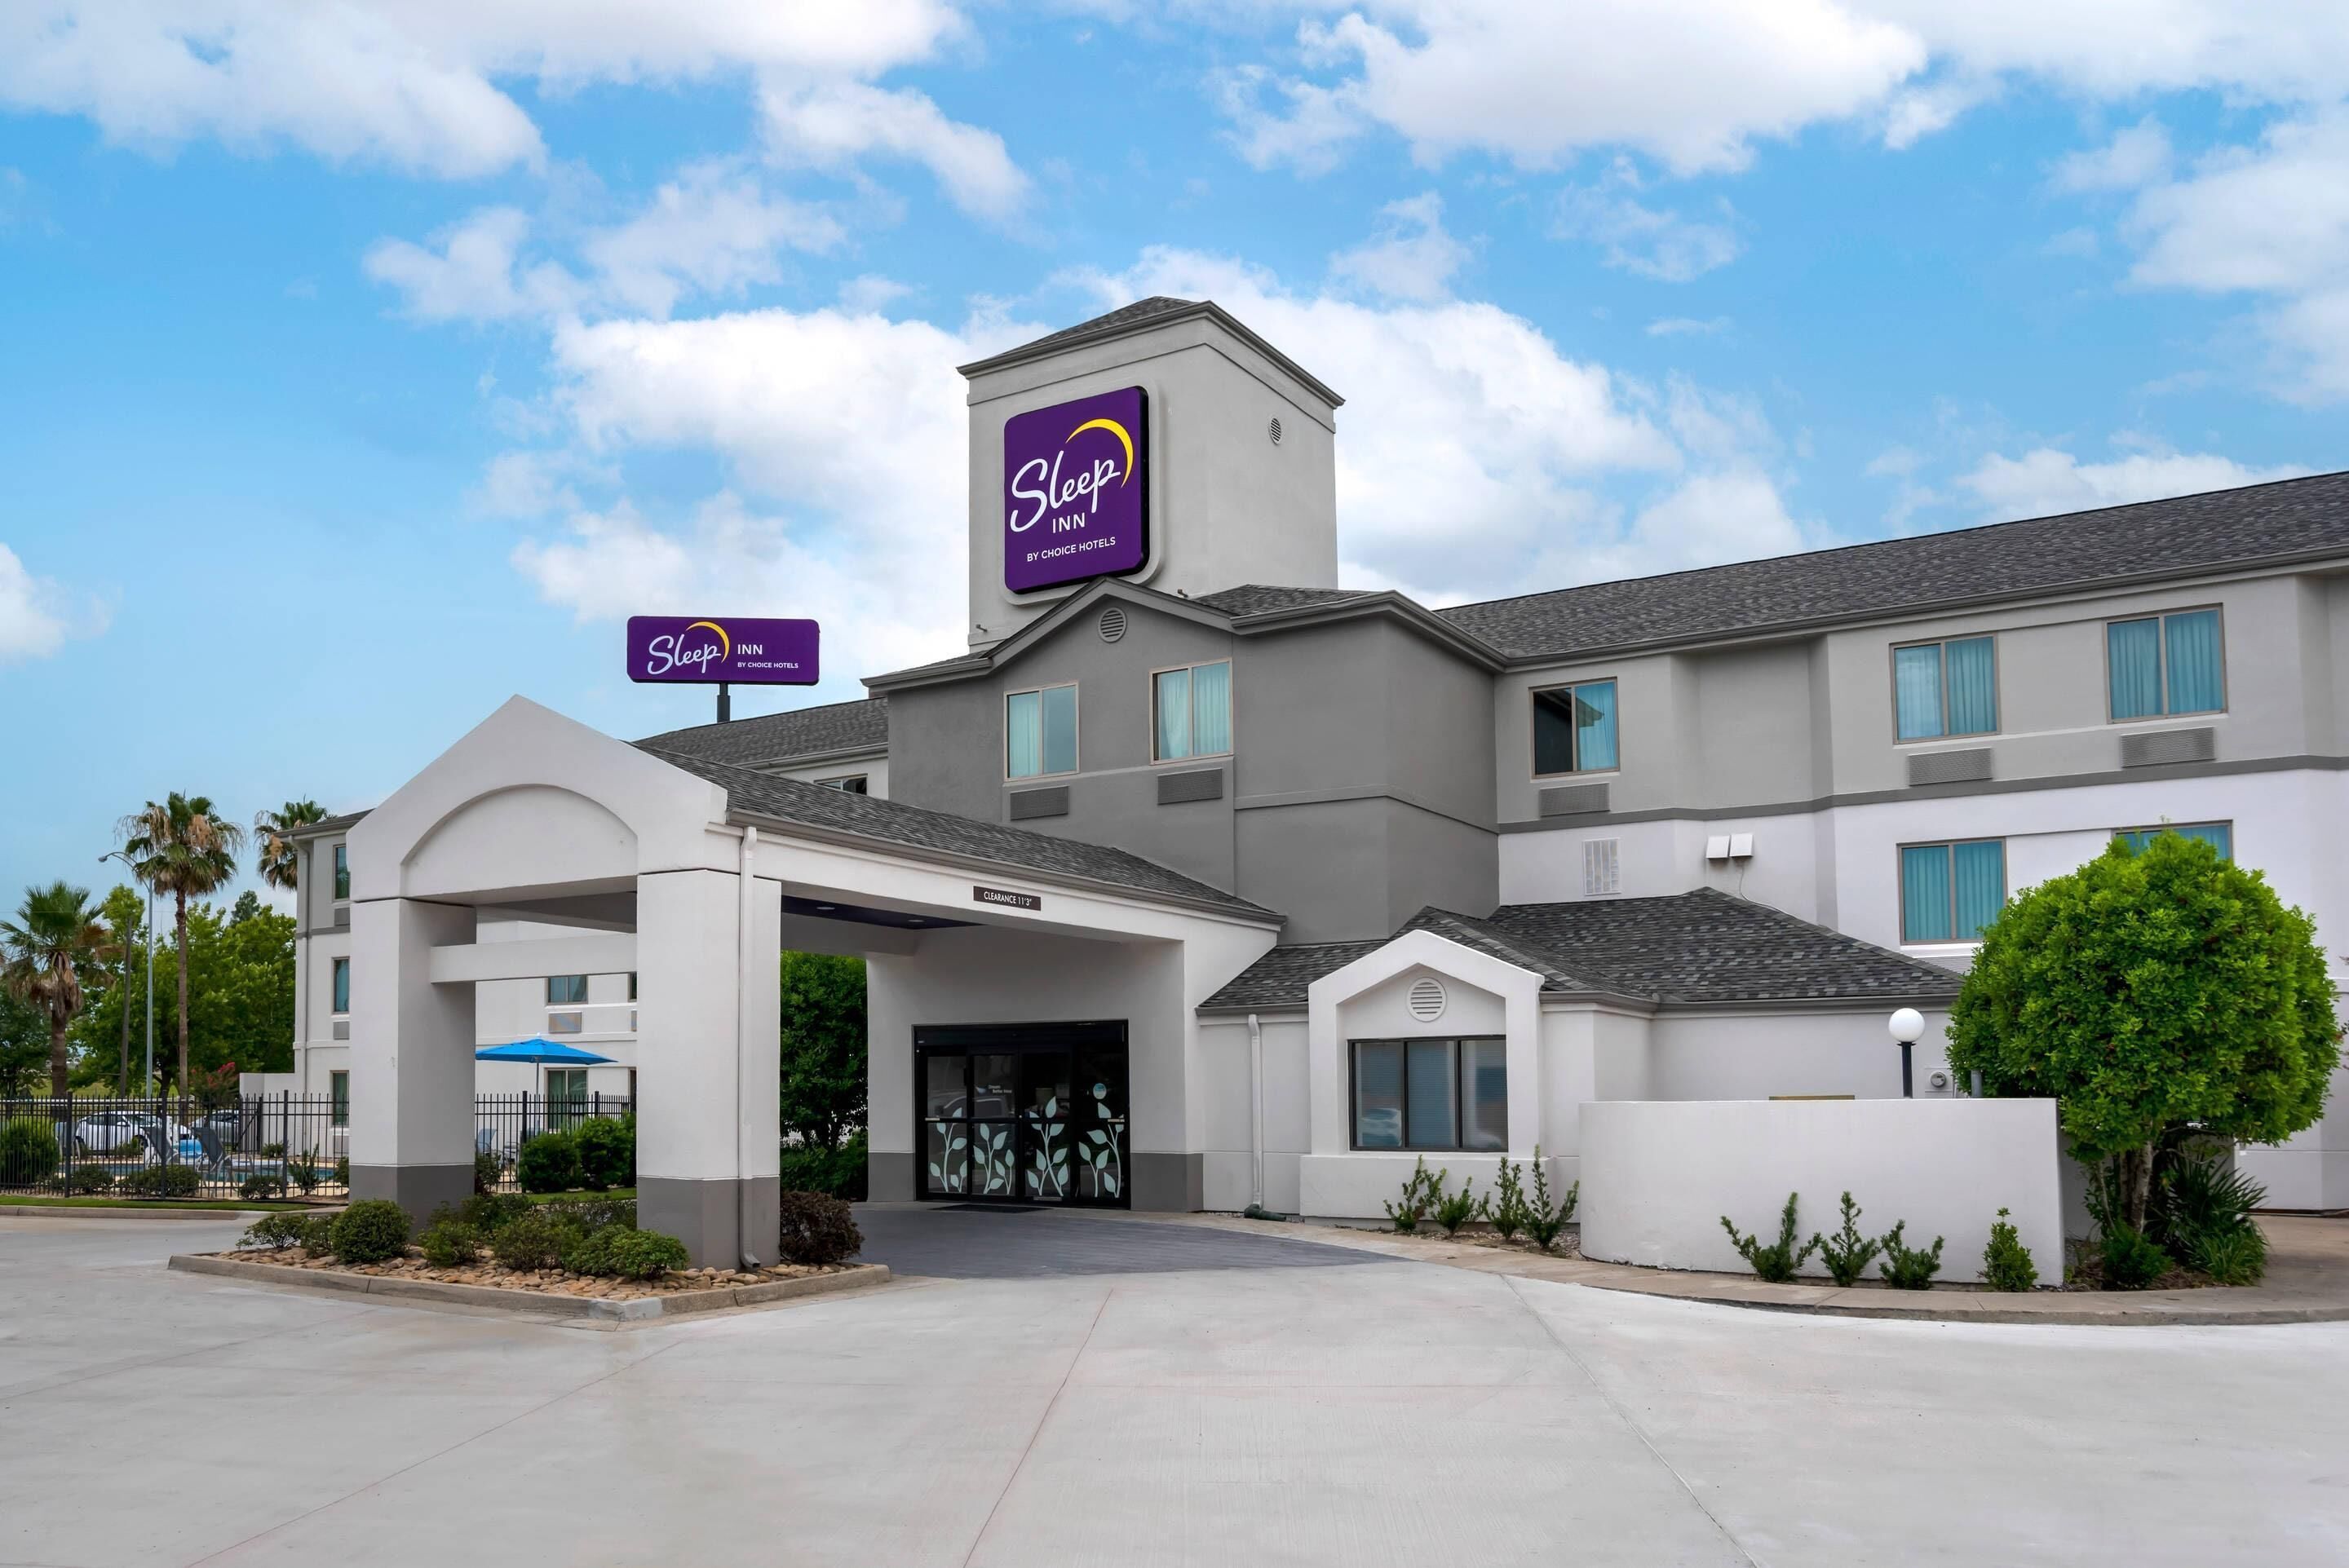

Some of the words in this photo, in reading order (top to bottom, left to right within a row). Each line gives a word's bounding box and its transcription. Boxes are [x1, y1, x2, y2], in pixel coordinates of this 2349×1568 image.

[1010, 450, 1121, 532] Sleep
[1052, 512, 1086, 533] INN
[1027, 552, 1039, 562] BY
[1041, 544, 1077, 559] CHOICE
[1078, 537, 1116, 552] HOTELS
[647, 634, 722, 675] Sleep
[737, 643, 763, 655] INN
[984, 891, 1016, 903] CLEARANCE
